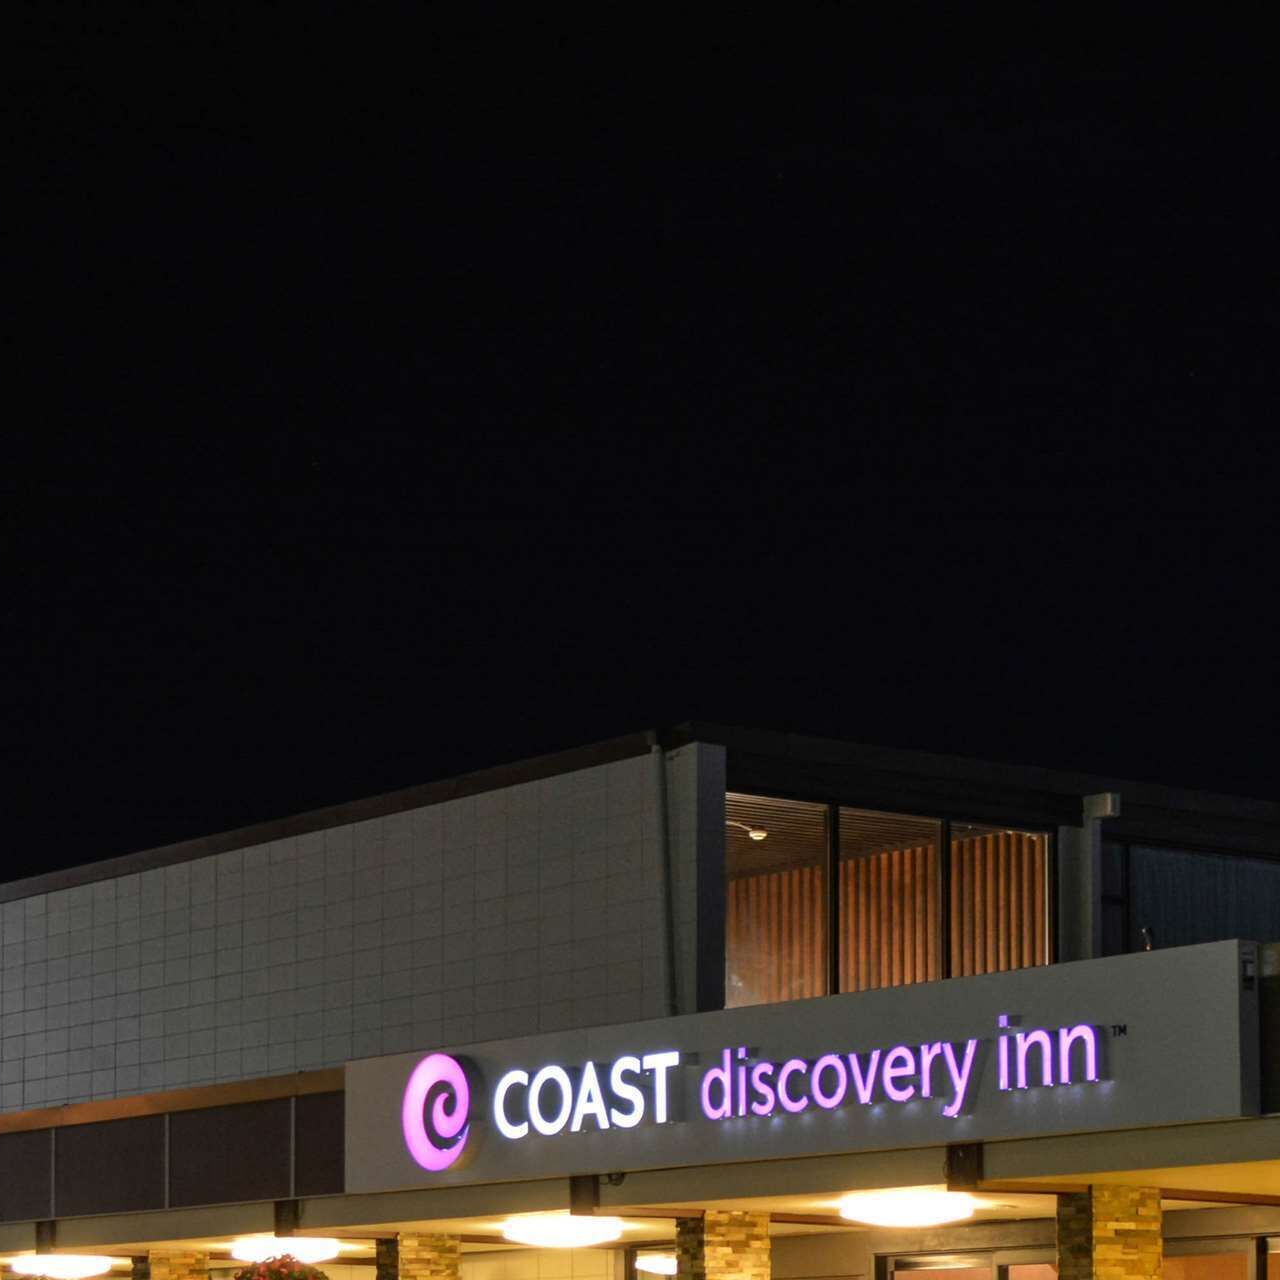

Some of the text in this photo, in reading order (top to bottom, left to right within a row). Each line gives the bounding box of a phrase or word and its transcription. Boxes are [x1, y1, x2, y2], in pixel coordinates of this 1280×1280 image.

[493, 1051, 679, 1140] COAST
[700, 1038, 978, 1120] discovery
[998, 1014, 1097, 1091] inn
